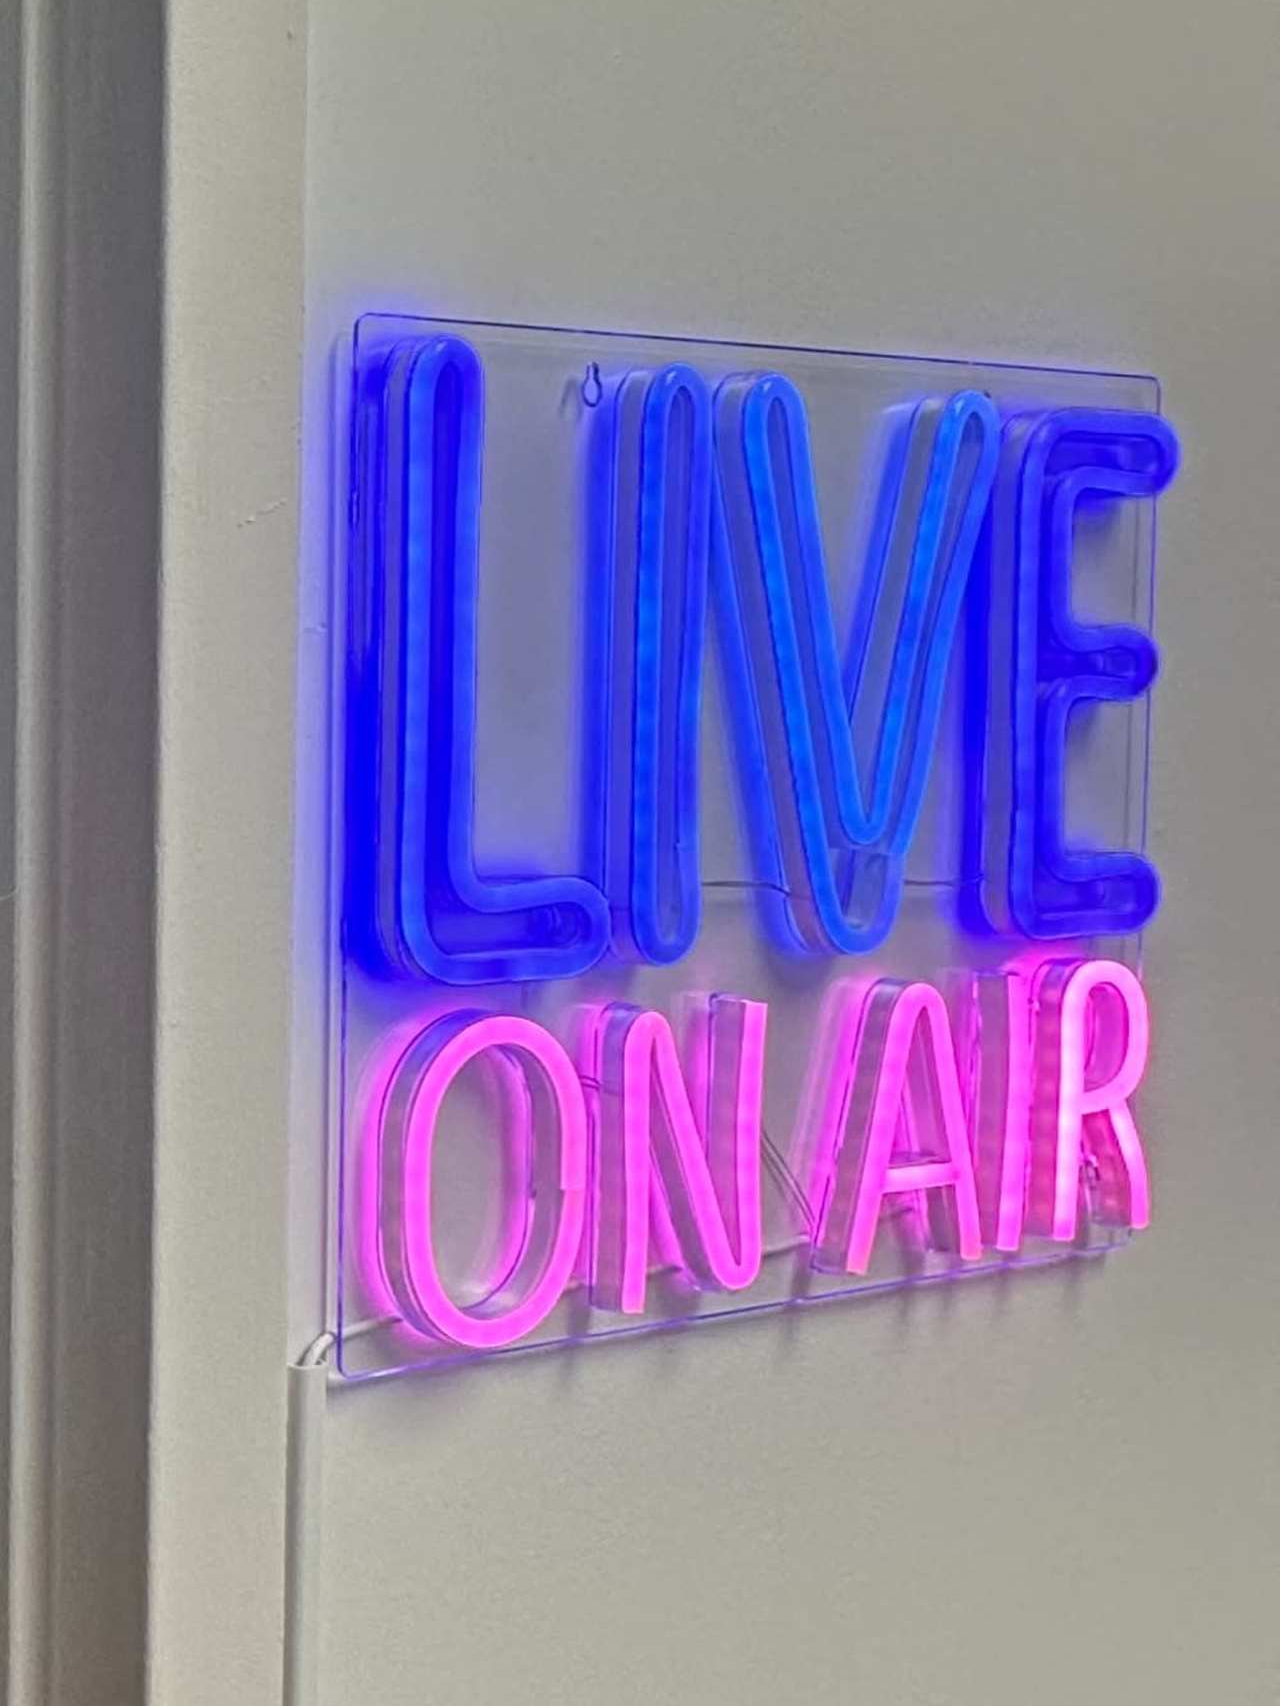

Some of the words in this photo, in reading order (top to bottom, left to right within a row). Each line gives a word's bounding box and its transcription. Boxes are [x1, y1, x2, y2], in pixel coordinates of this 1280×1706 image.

[382, 335, 1180, 984] LIVE
[385, 991, 767, 1348] ON
[818, 958, 1148, 1274] AIR
